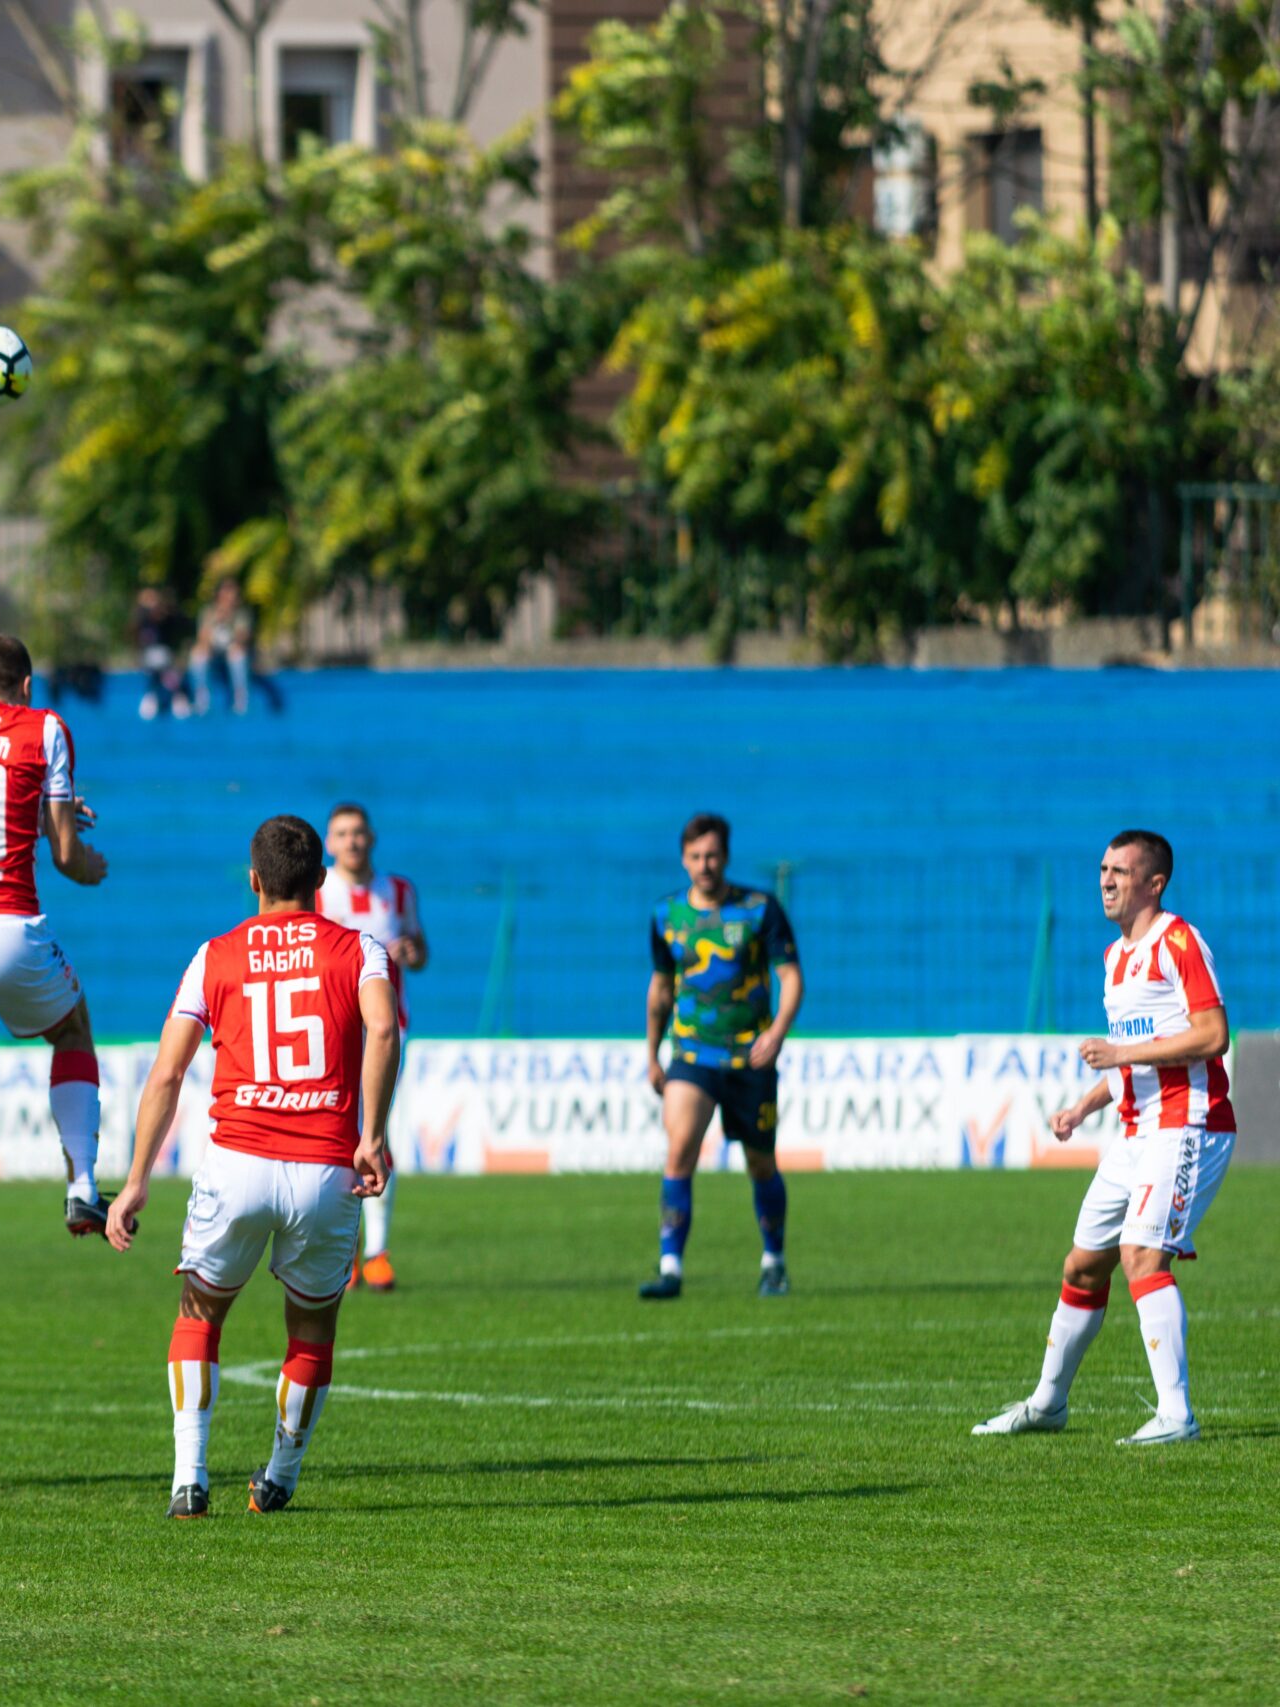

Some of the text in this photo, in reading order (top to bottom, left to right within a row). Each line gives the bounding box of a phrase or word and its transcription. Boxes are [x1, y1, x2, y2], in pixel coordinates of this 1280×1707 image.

[247, 921, 317, 946] mts
[248, 946, 314, 973] БАБИЋ
[242, 976, 326, 1083] 15
[1137, 1184, 1154, 1216] 7
